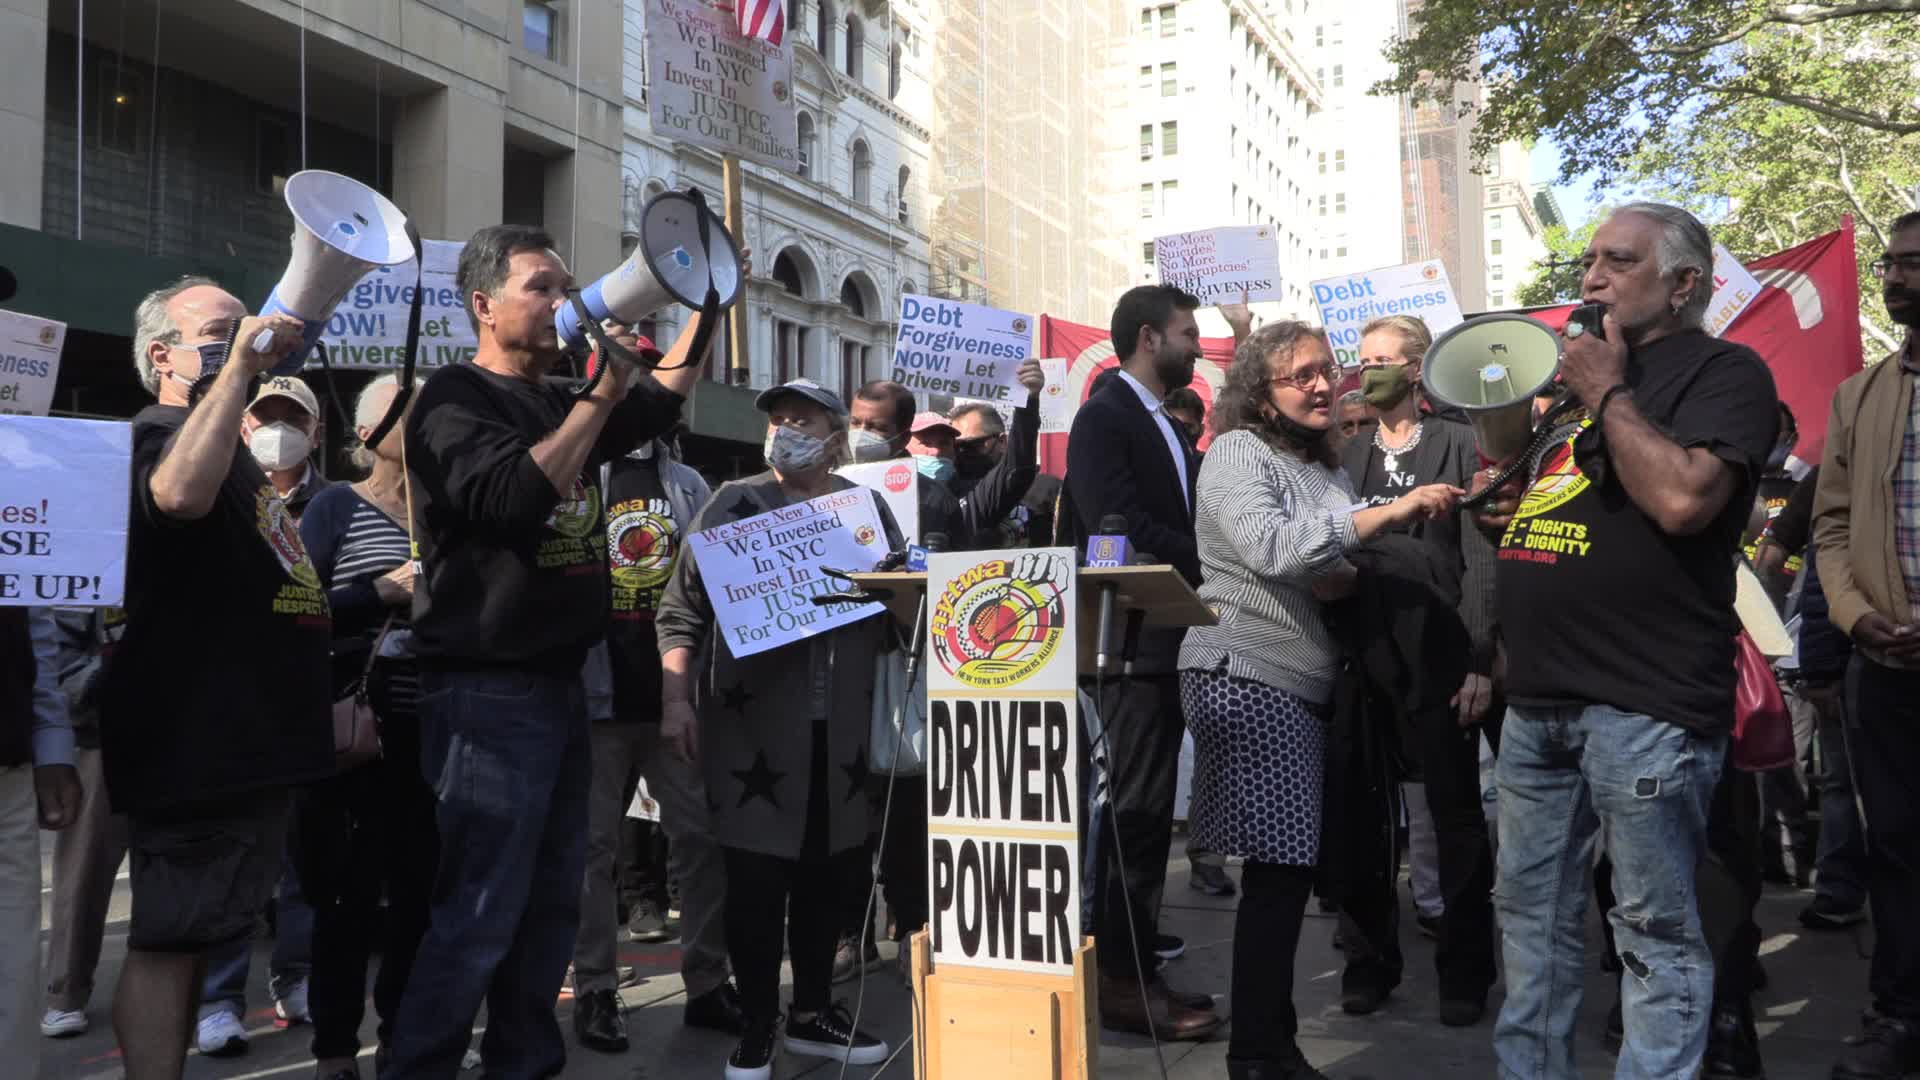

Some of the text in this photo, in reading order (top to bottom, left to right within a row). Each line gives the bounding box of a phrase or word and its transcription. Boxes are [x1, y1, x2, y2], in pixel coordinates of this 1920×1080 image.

[676, 21, 707, 49] We
[712, 35, 767, 73] Invested
[664, 60, 737, 101] Invest In
[695, 51, 753, 87] In NYC
[661, 103, 795, 161] For Our Families
[1158, 233, 1214, 250] No More
[1158, 242, 1217, 262] Suicides!
[1160, 255, 1216, 273] No More
[1314, 277, 1377, 305] Debt
[1321, 289, 1448, 326] Forgiveness
[418, 316, 453, 338] et
[902, 298, 965, 328] Debt
[898, 323, 1026, 361] Forgiveness
[892, 367, 962, 394] Drivers
[894, 349, 997, 379] NOW! Let
[885, 472, 911, 486] STOP
[701, 493, 859, 544] We Serve New Yorkers
[724, 536, 762, 558] We
[766, 510, 844, 548] Invested
[1529, 518, 1588, 540] RIGHTS
[751, 537, 827, 575] In NYC
[1524, 534, 1592, 557] DIGNITY
[32, 574, 102, 600] UP!
[722, 565, 812, 605] Invest In
[760, 575, 854, 621] JUSTIC
[931, 559, 1007, 638] nytwa
[733, 622, 773, 646] For
[775, 609, 817, 633] Our
[973, 677, 992, 687] YORK
[993, 674, 1009, 686] TAXI
[1009, 658, 1041, 681] WORKERS
[1039, 627, 1060, 662] ALLIANCE
[931, 700, 1072, 824] DRIVER
[932, 838, 1074, 966] POWER
